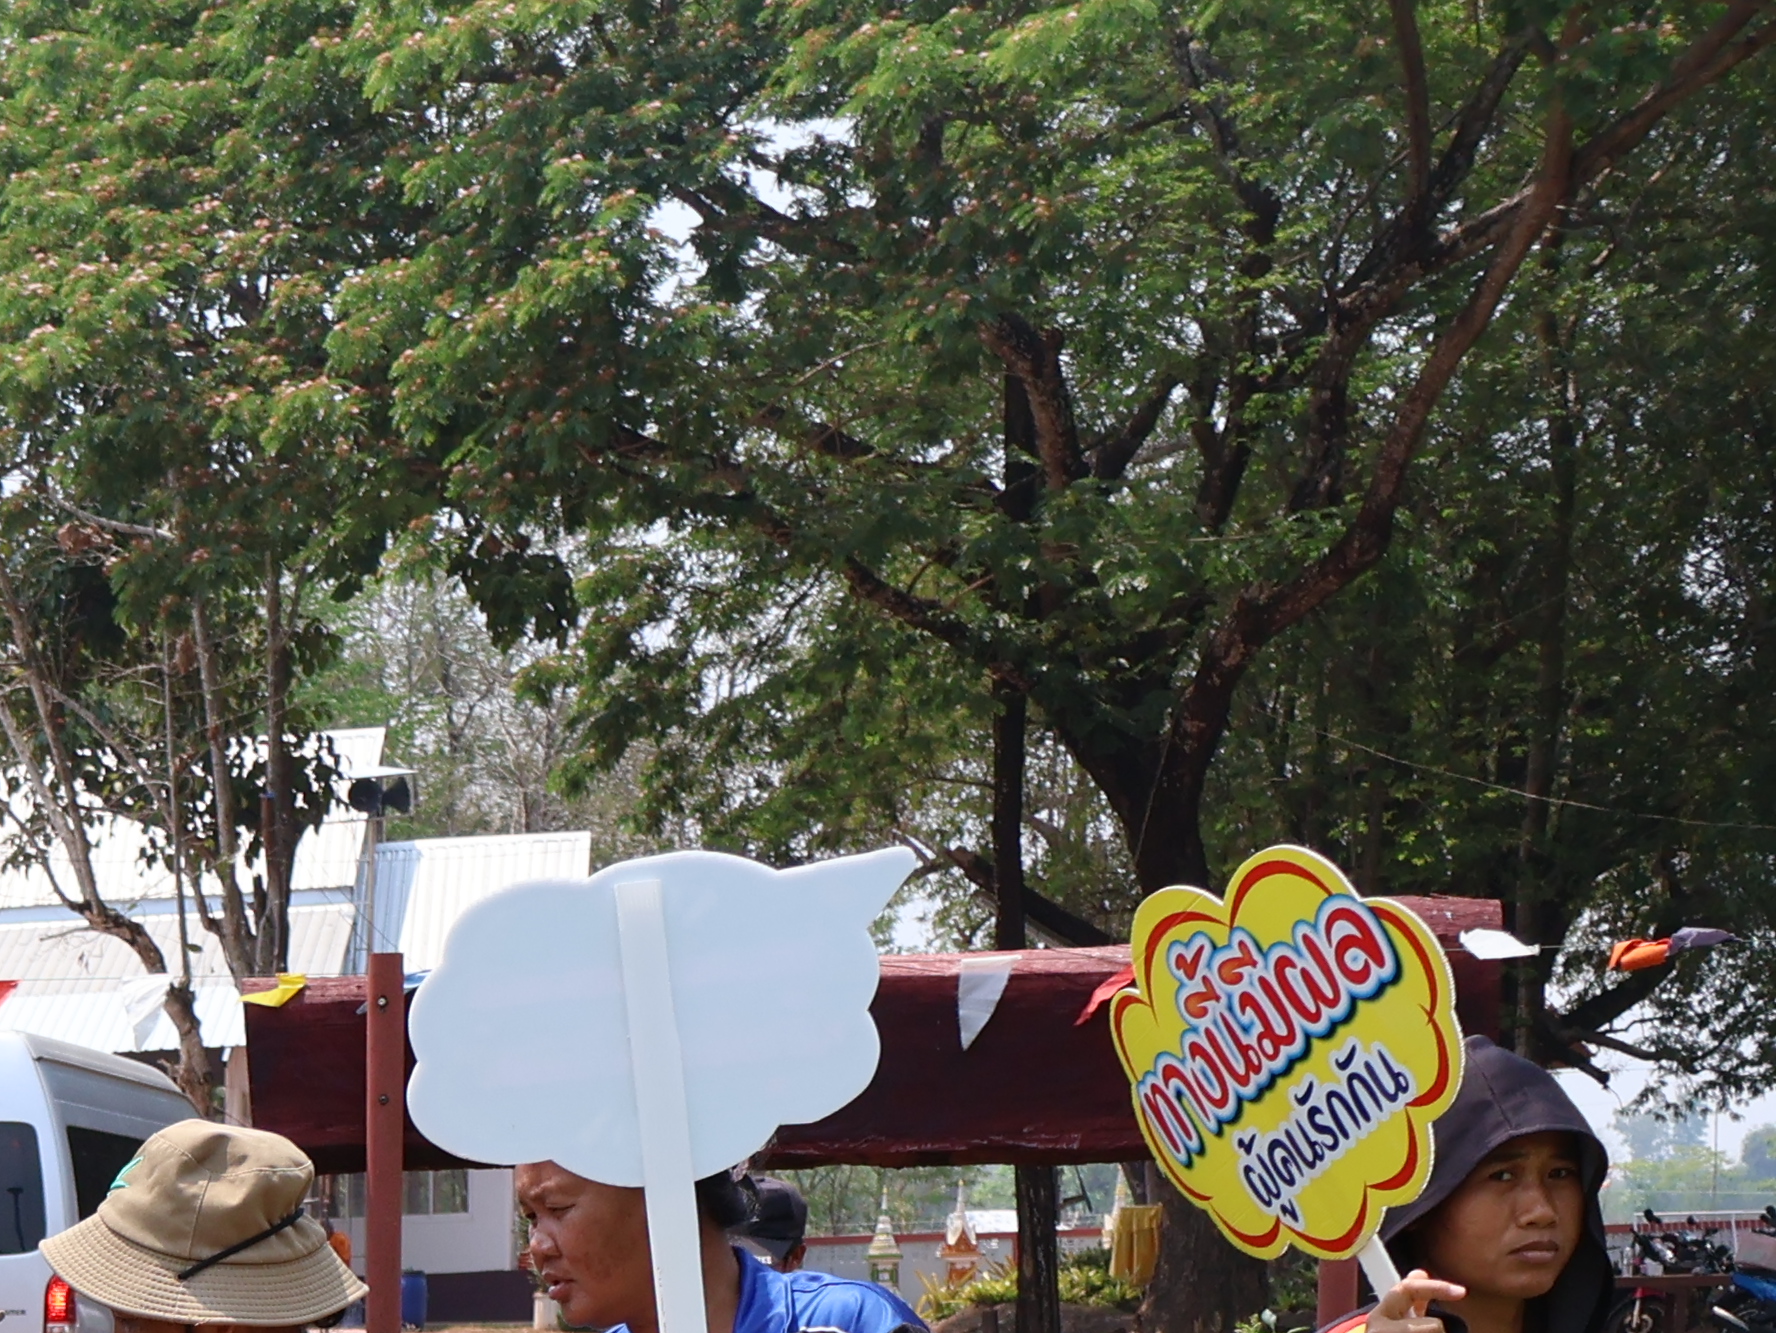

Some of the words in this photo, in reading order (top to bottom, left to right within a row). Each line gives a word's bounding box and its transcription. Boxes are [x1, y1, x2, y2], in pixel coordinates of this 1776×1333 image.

[1142, 906, 1388, 1158] ทางนี้มีผล
[1243, 1044, 1410, 1223] ผู้คนรักกัน
